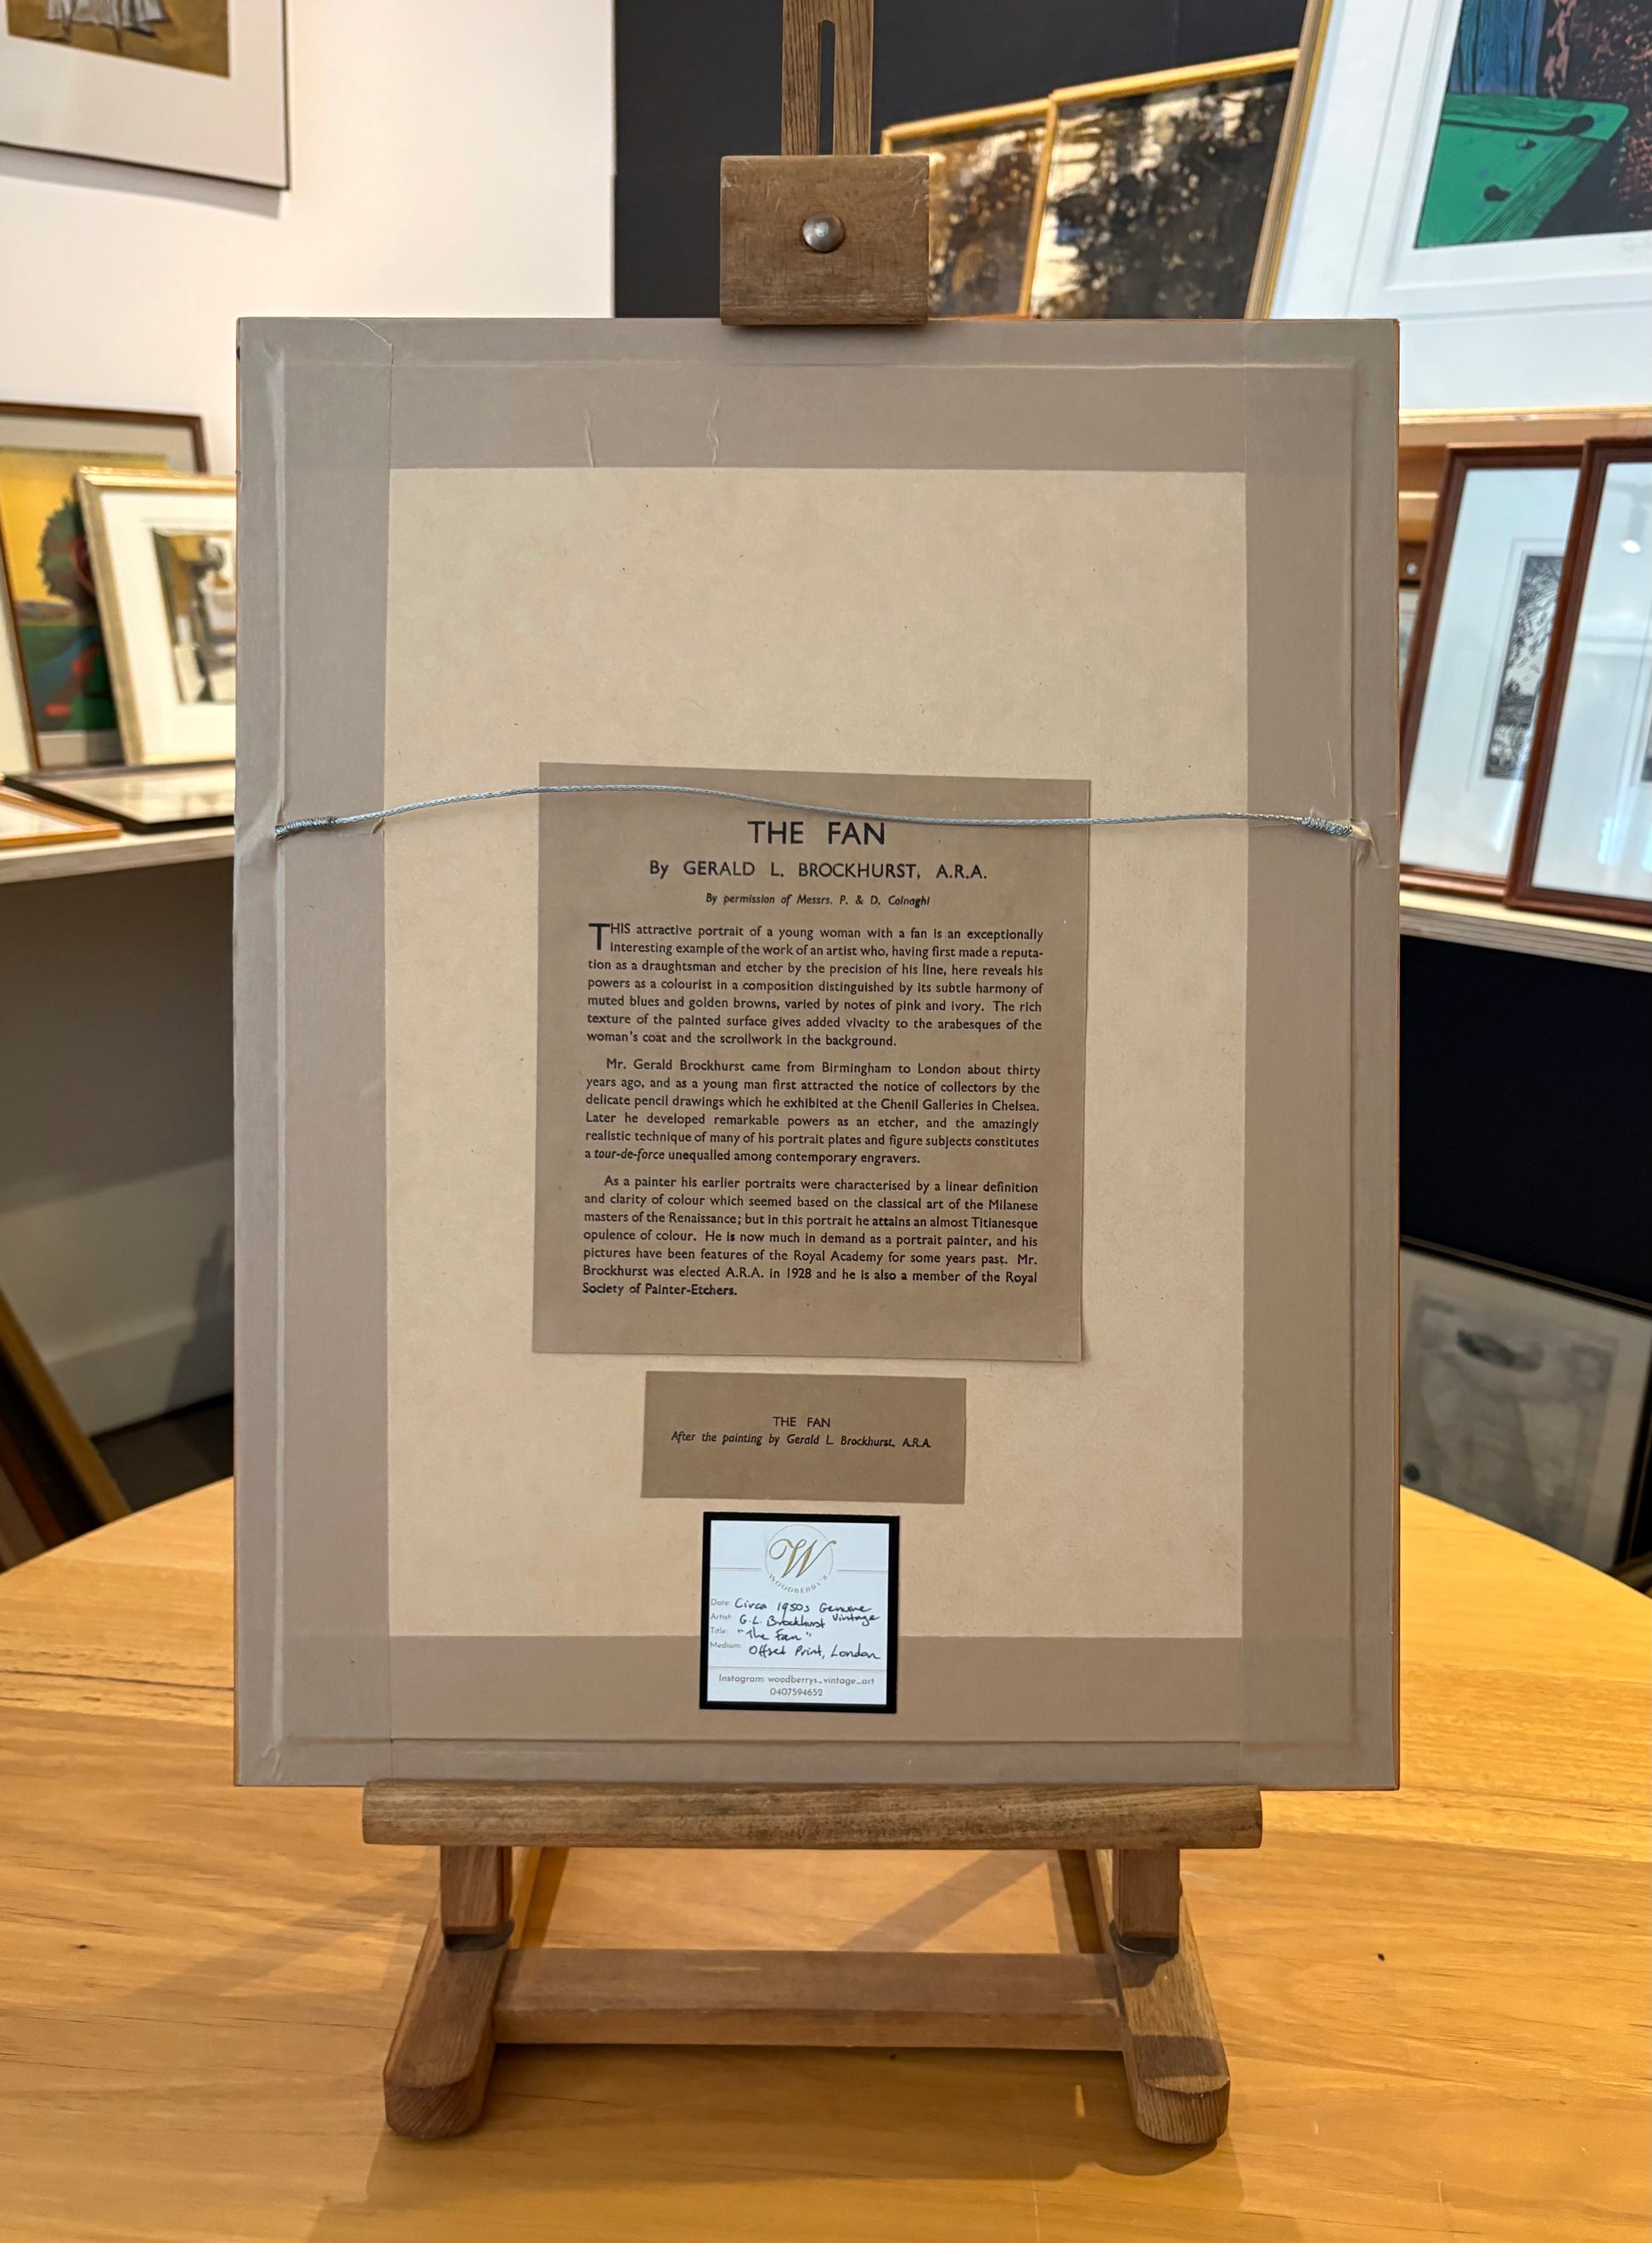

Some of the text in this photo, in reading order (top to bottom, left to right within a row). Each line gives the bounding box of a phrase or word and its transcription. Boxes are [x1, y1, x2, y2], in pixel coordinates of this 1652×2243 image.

[747, 821, 885, 846] THE FAN
[649, 860, 987, 880] By GERALD L. BROCKHURST, A.R.A.
[705, 892, 930, 908] By permission of Messrs. P. & D. Colnaghi
[637, 925, 692, 936] attractive
[698, 925, 744, 939] portrait
[750, 925, 762, 936] of
[778, 929, 814, 941] young
[819, 930, 861, 938] woman
[867, 927, 893, 939] with
[910, 927, 927, 939] fan
[934, 928, 942, 939] is
[947, 930, 961, 939] an
[967, 928, 1043, 943] exceptionally
[588, 958, 1043, 977] tion as a draughtsman and etcher by the precision of his line, here reveals his
[587, 1031, 896, 1049] woman's coat and the scrollwork in the background.
[606, 1058, 1041, 1079] Mr. Gerald Brockhurst came from Birmingham to London about thirty
[586, 1111, 1039, 1133] Later he developed remarkable powers as an etcher, and the amazingly
[585, 1148, 920, 1166] a tour-de-force unequalled among contemporary engravers.
[604, 1175, 619, 1186] As
[635, 1177, 677, 1190] painter
[681, 1176, 697, 1188] his
[702, 1177, 740, 1189] earlier
[745, 1178, 795, 1192] portraits
[801, 1181, 830, 1189] were
[834, 1178, 910, 1191] characterised
[916, 1179, 930, 1195] by
[946, 1180, 979, 1192] linear
[983, 1181, 1038, 1193] definition
[583, 1228, 636, 1243] opulence
[640, 1228, 653, 1240] of
[655, 1229, 697, 1241] colour.
[705, 1230, 722, 1241] He
[727, 1231, 735, 1242] is
[740, 1234, 765, 1242] now
[769, 1231, 800, 1243] much
[805, 1233, 816, 1243] in
[820, 1232, 865, 1244] demand
[885, 1236, 892, 1245] a
[896, 1234, 942, 1248] portrait
[947, 1235, 992, 1249] painter,
[997, 1235, 1017, 1246] and
[1022, 1235, 1038, 1247] his
[583, 1264, 649, 1276] Brockhurst
[653, 1268, 674, 1277] was
[679, 1266, 720, 1277] elected
[725, 1267, 764, 1278] A.R.A.
[770, 1268, 780, 1279] in
[787, 1268, 812, 1279] 1928
[816, 1268, 837, 1279] and
[842, 1268, 856, 1279] he
[861, 1269, 869, 1280] is
[874, 1268, 896, 1280] also
[913, 1270, 961, 1282] member
[965, 1270, 978, 1282] of
[981, 1270, 1000, 1282] the
[1006, 1271, 1037, 1286] Royal
[773, 1416, 830, 1428] THE FAN
[671, 1430, 696, 1442] After
[701, 1431, 717, 1442] the
[722, 1432, 763, 1447] painting
[768, 1433, 780, 1447] by
[786, 1433, 820, 1445] Gerald
[840, 1435, 896, 1448] Brockhurst,
[768, 1538, 837, 1578] W
[734, 1597, 767, 1610] Circa
[777, 1601, 810, 1620] 1950s
[818, 1602, 872, 1613] Genuine
[832, 1613, 880, 1627] Vintage
[749, 1644, 787, 1658] Offset
[830, 1643, 881, 1660] London
[718, 1673, 766, 1684] Instagram:
[770, 1687, 823, 1697] 0407594652
